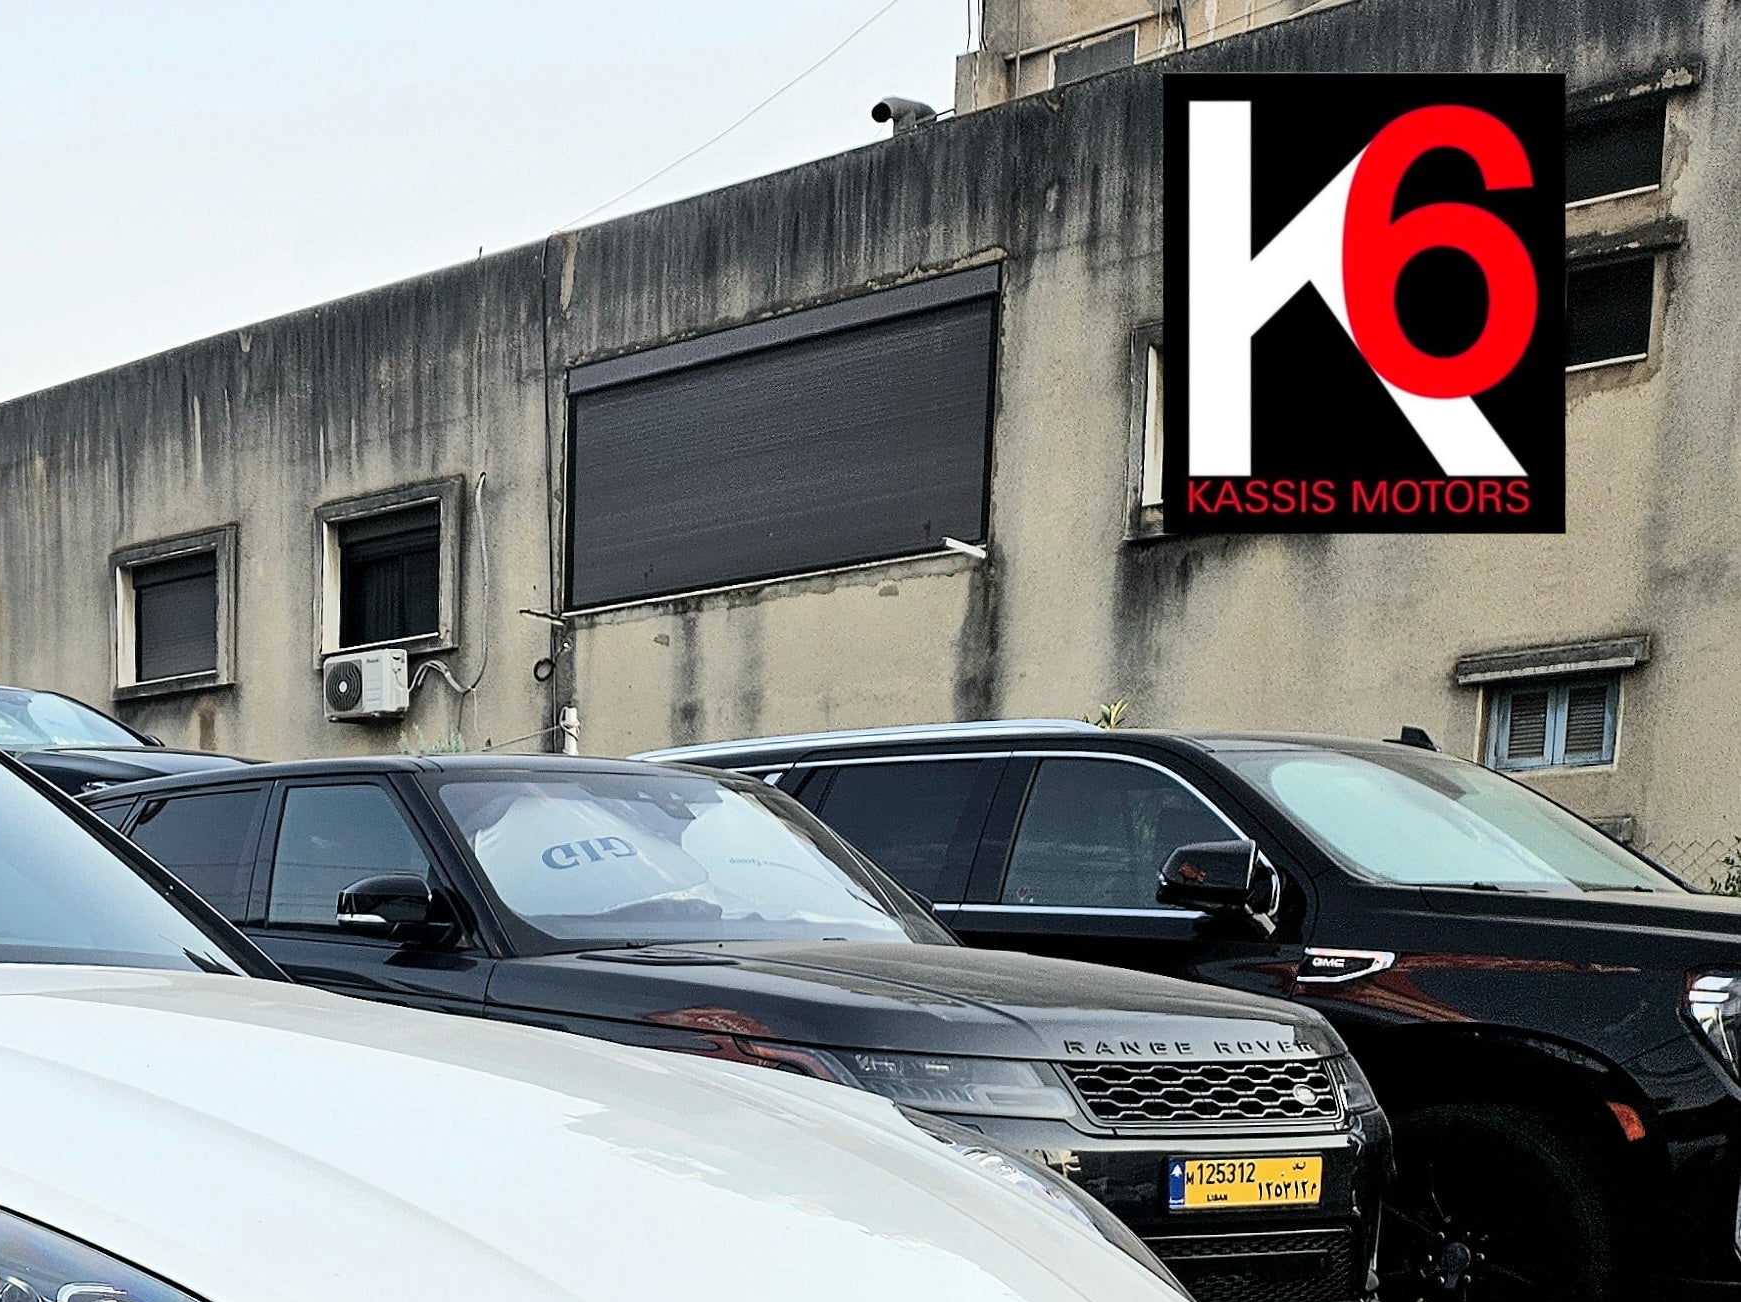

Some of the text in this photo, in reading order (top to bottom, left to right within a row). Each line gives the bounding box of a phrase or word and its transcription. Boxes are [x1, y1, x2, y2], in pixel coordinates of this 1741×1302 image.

[1312, 958, 1346, 968] GMC
[1063, 1040, 1315, 1055] RANGE ROVER
